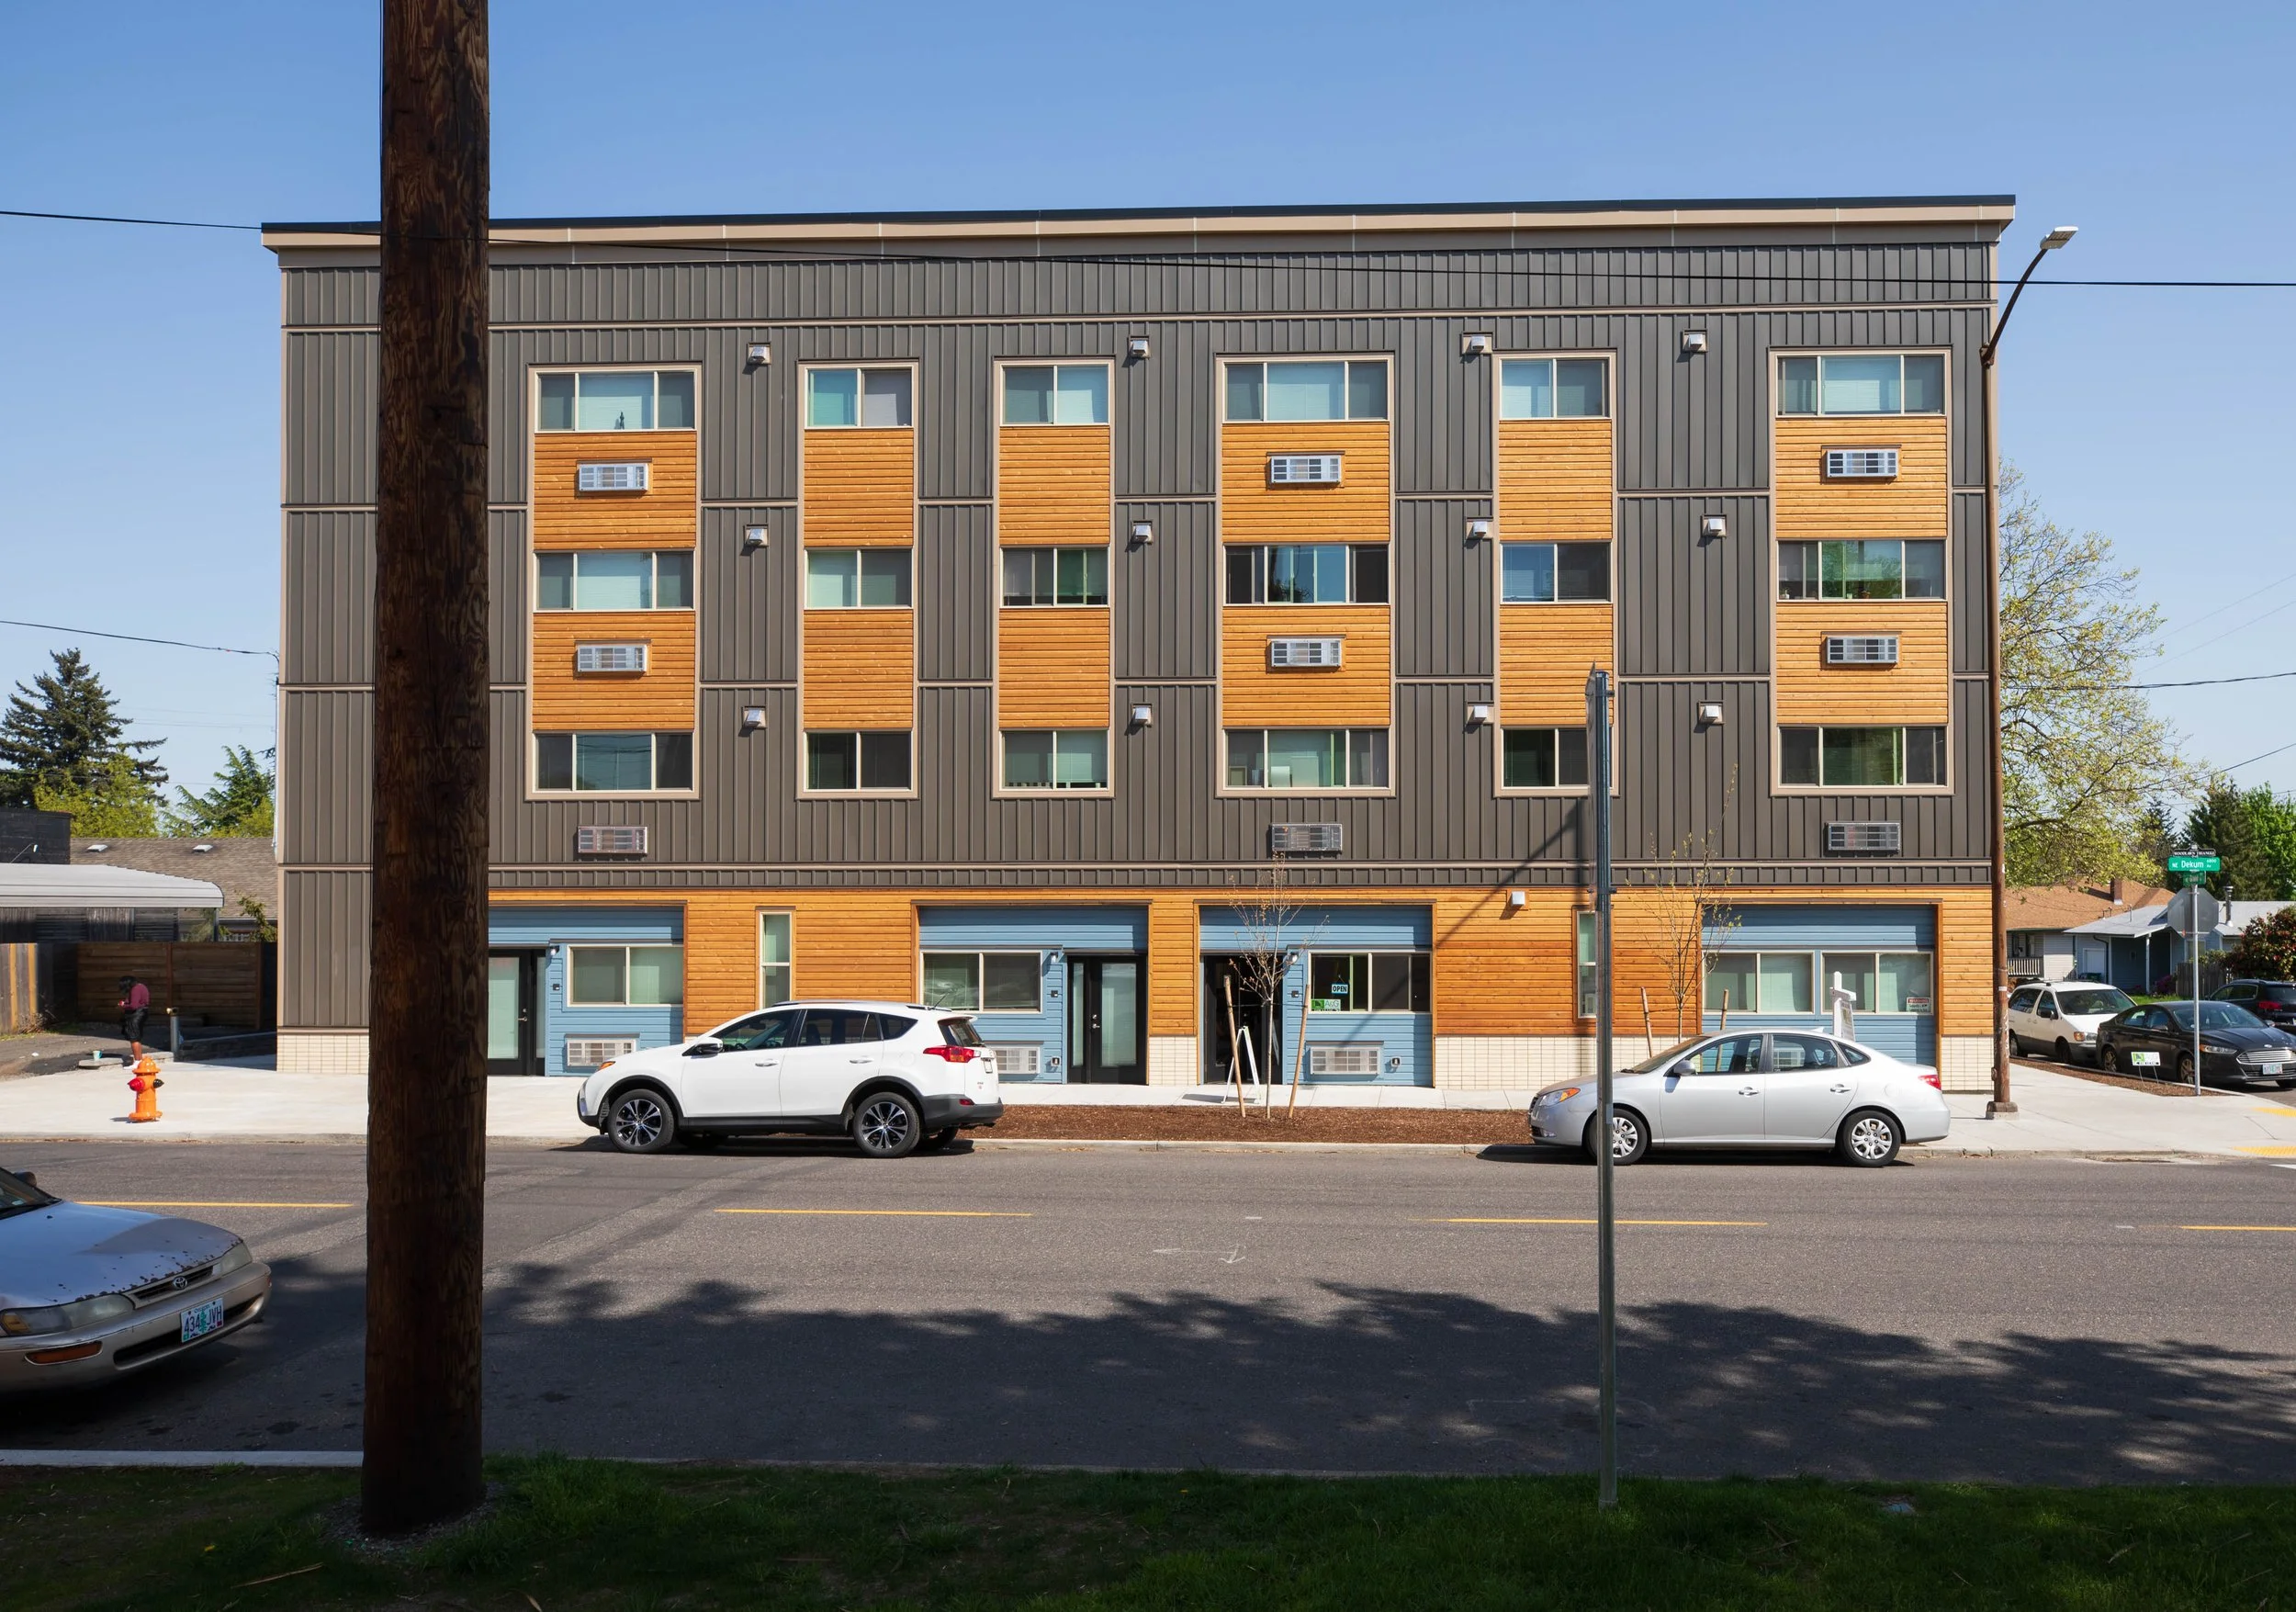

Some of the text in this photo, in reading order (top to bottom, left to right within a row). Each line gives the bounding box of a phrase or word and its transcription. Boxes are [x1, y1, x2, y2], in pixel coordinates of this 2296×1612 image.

[2181, 860, 2204, 868] Dekum
[1324, 999, 1339, 1008] A&G
[185, 1305, 222, 1332] 434 JVH
